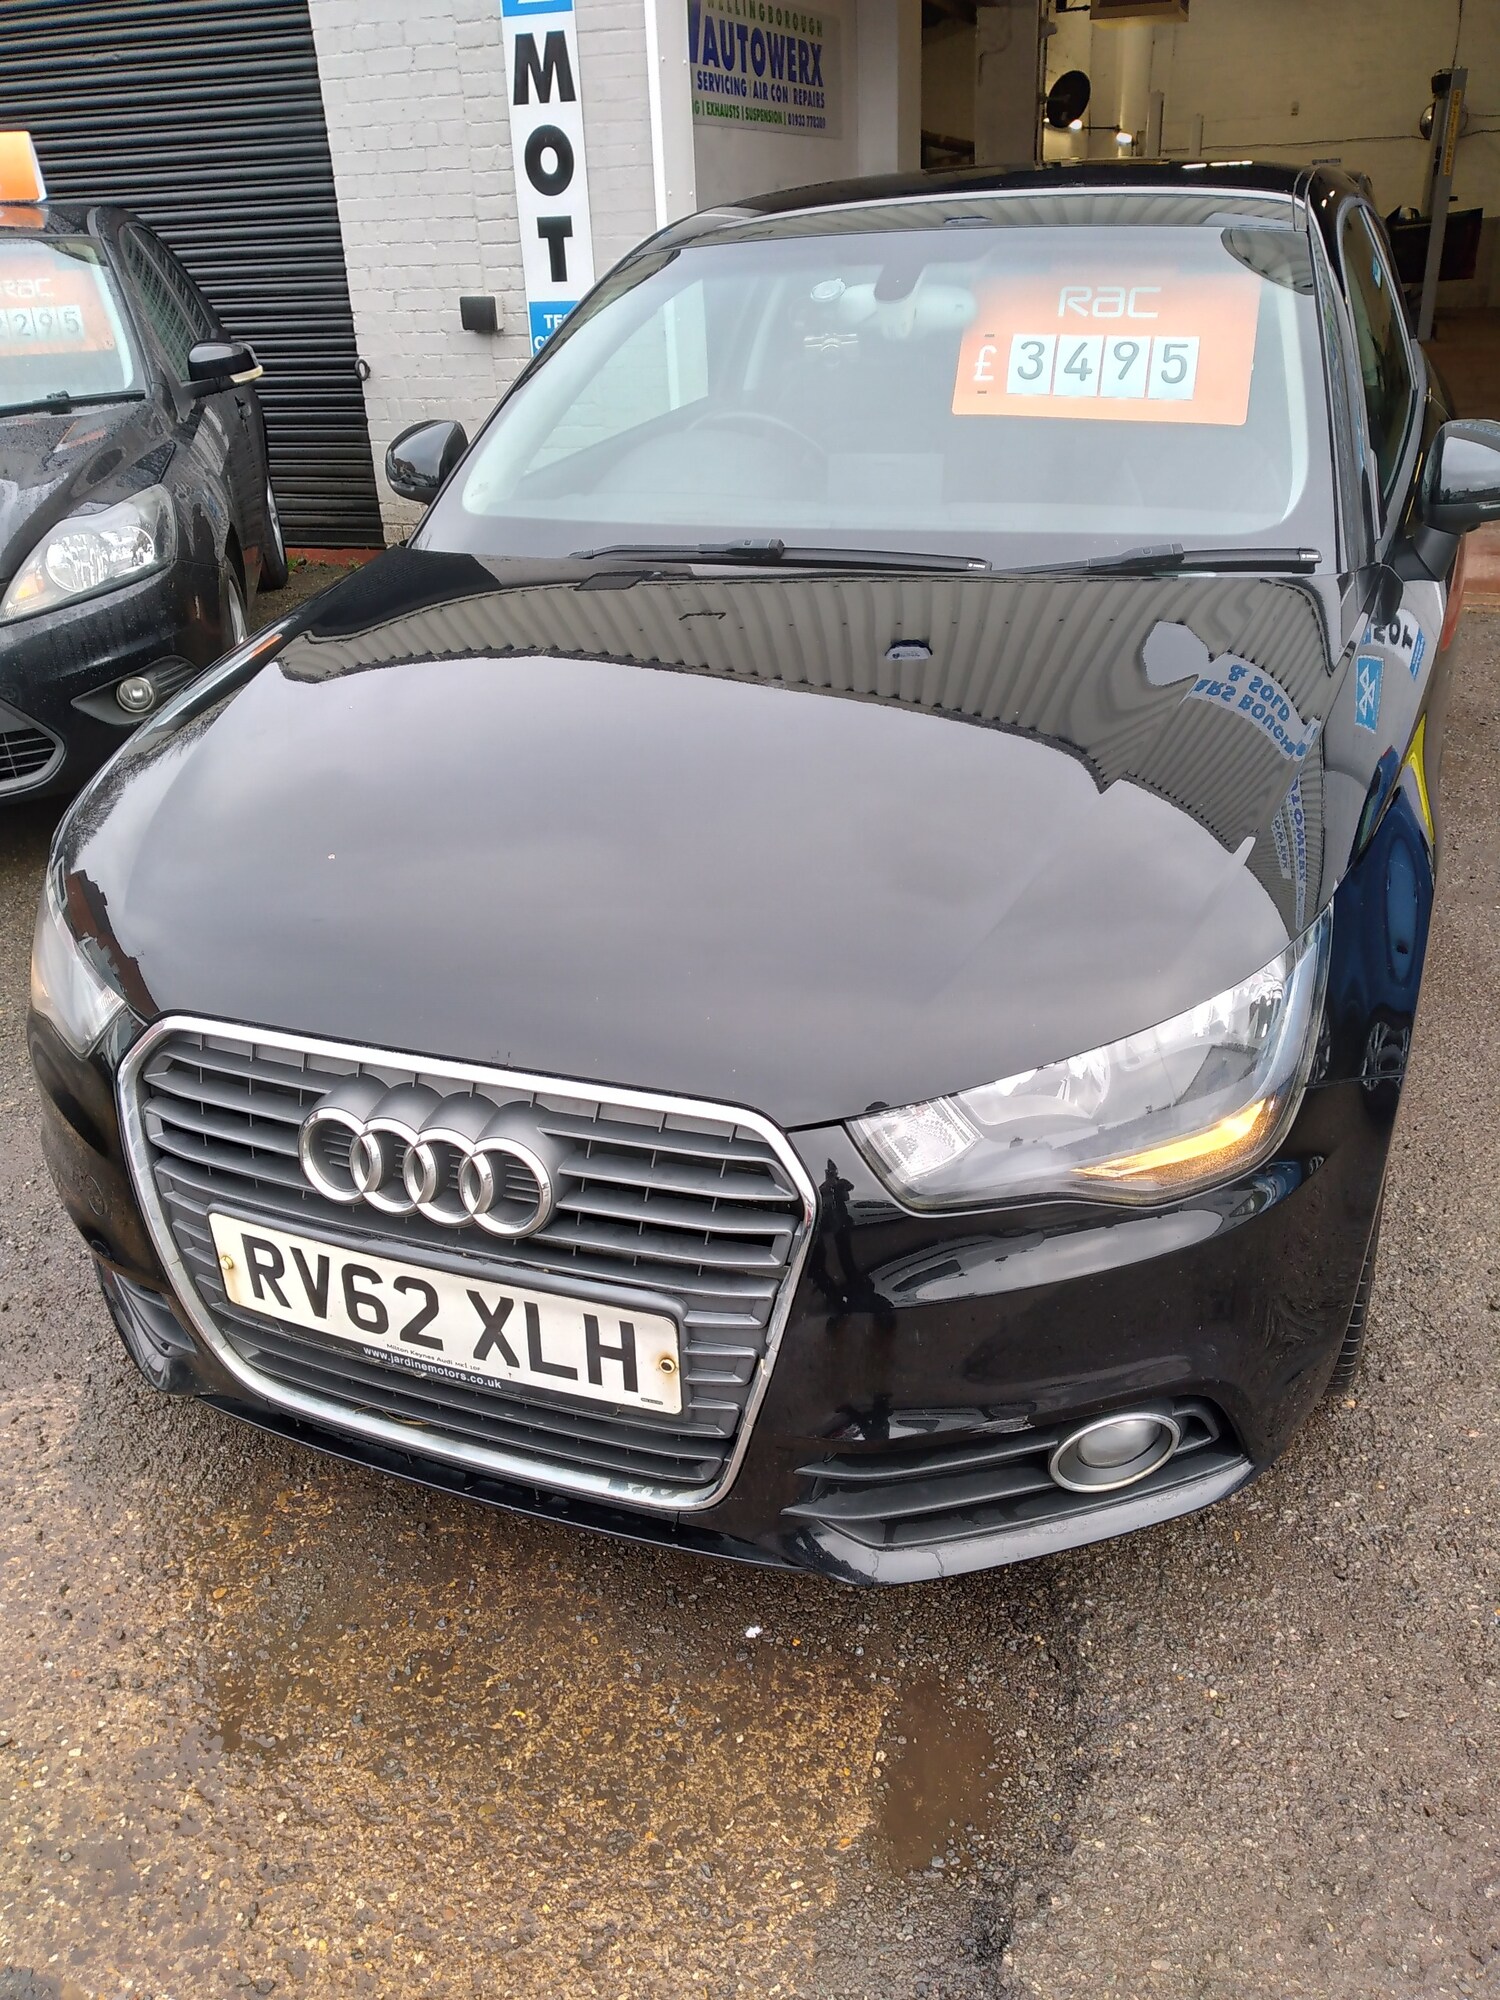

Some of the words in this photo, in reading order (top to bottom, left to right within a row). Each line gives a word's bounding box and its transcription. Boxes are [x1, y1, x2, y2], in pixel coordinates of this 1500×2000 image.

[702, 15, 824, 87] AUTOWERX
[697, 71, 747, 97] SERVICING
[753, 81, 768, 100] AIR
[771, 84, 789, 103] CON
[794, 88, 825, 109] REPAIRS
[706, 101, 740, 119] EXHAUSTS
[745, 107, 783, 125] SUSPENSION
[513, 30, 576, 283] MOT
[0, 311, 79, 337] 295
[240, 1233, 444, 1351] RV62
[466, 1289, 639, 1393] XLH
[363, 1346, 502, 1390] www.jardinemotors.co.uk
[386, 1343, 409, 1354] Milton
[410, 1349, 435, 1361] Keynes
[436, 1356, 453, 1366] Audi
